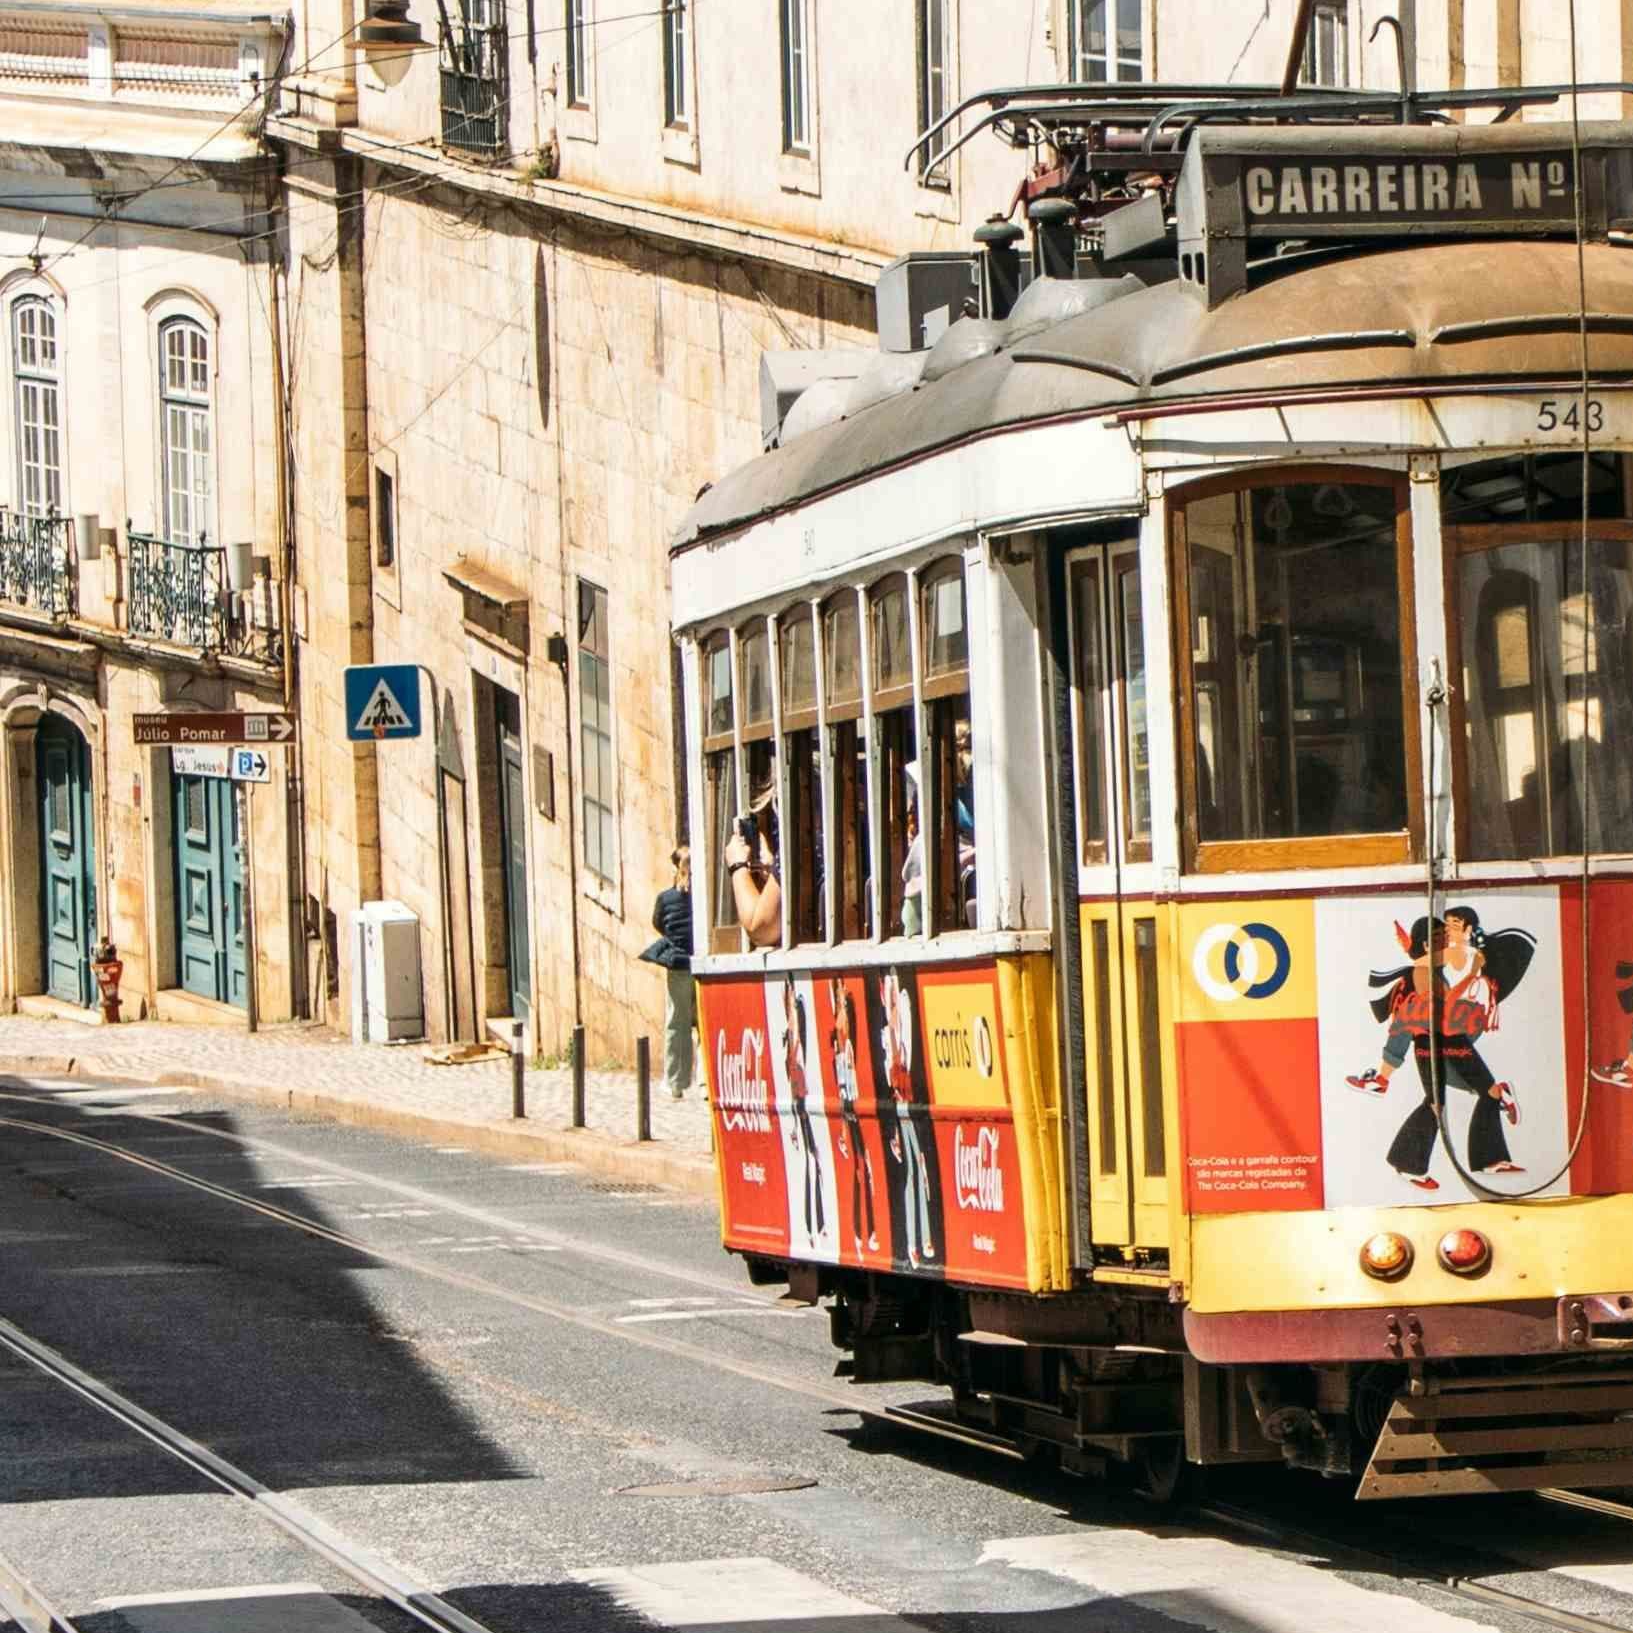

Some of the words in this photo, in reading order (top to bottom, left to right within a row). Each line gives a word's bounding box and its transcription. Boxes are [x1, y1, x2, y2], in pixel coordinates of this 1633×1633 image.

[1245, 164, 1483, 215] CARREIRA
[1511, 162, 1566, 210] Nº
[1537, 400, 1604, 432] 543
[134, 715, 168, 724] museu
[135, 726, 170, 741] Júlio
[179, 726, 227, 741] Pomar
[934, 1011, 972, 1069] carris
[716, 1027, 773, 1134] Coca-Cola
[954, 1124, 1004, 1212] Coca-Cola
[1188, 1156, 1229, 1166] Coca-Cola
[1280, 1155, 1317, 1164] contour
[1198, 1181, 1212, 1191] The
[1213, 1179, 1259, 1190] Coca-Cola
[1213, 1169, 1243, 1178] marcas
